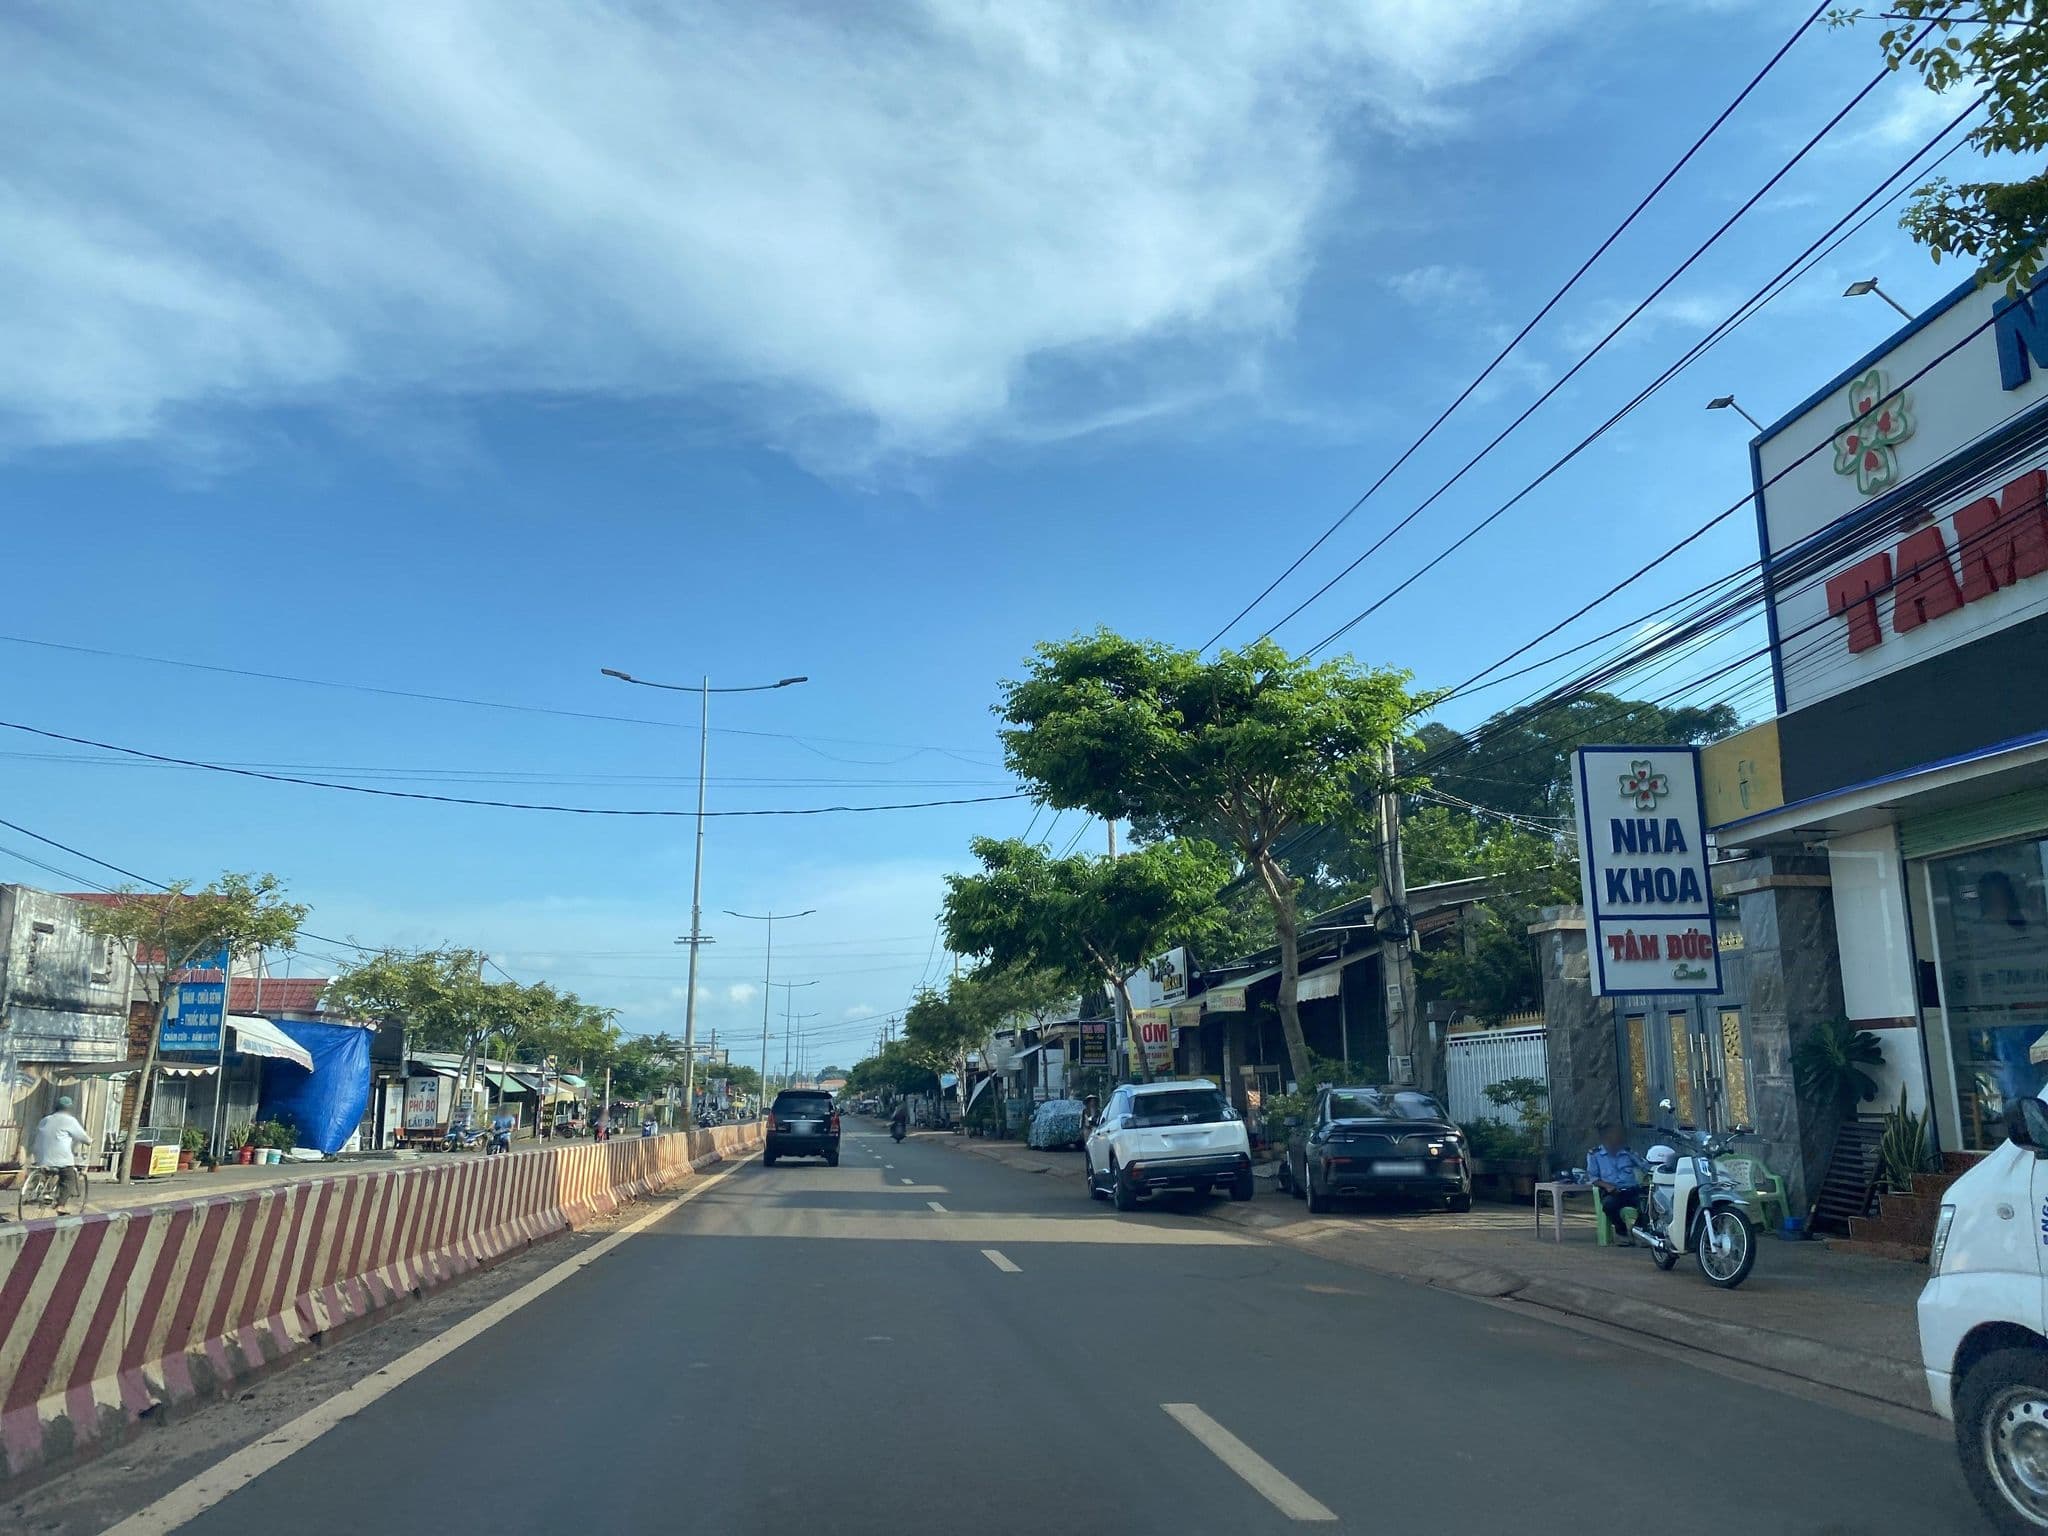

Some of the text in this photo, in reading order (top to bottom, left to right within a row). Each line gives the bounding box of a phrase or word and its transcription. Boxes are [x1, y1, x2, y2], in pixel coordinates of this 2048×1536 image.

[1610, 818, 1689, 854] NHA
[1605, 867, 1703, 904] KHOA
[1607, 928, 1660, 961] TÂM
[420, 1081, 436, 1092] 72
